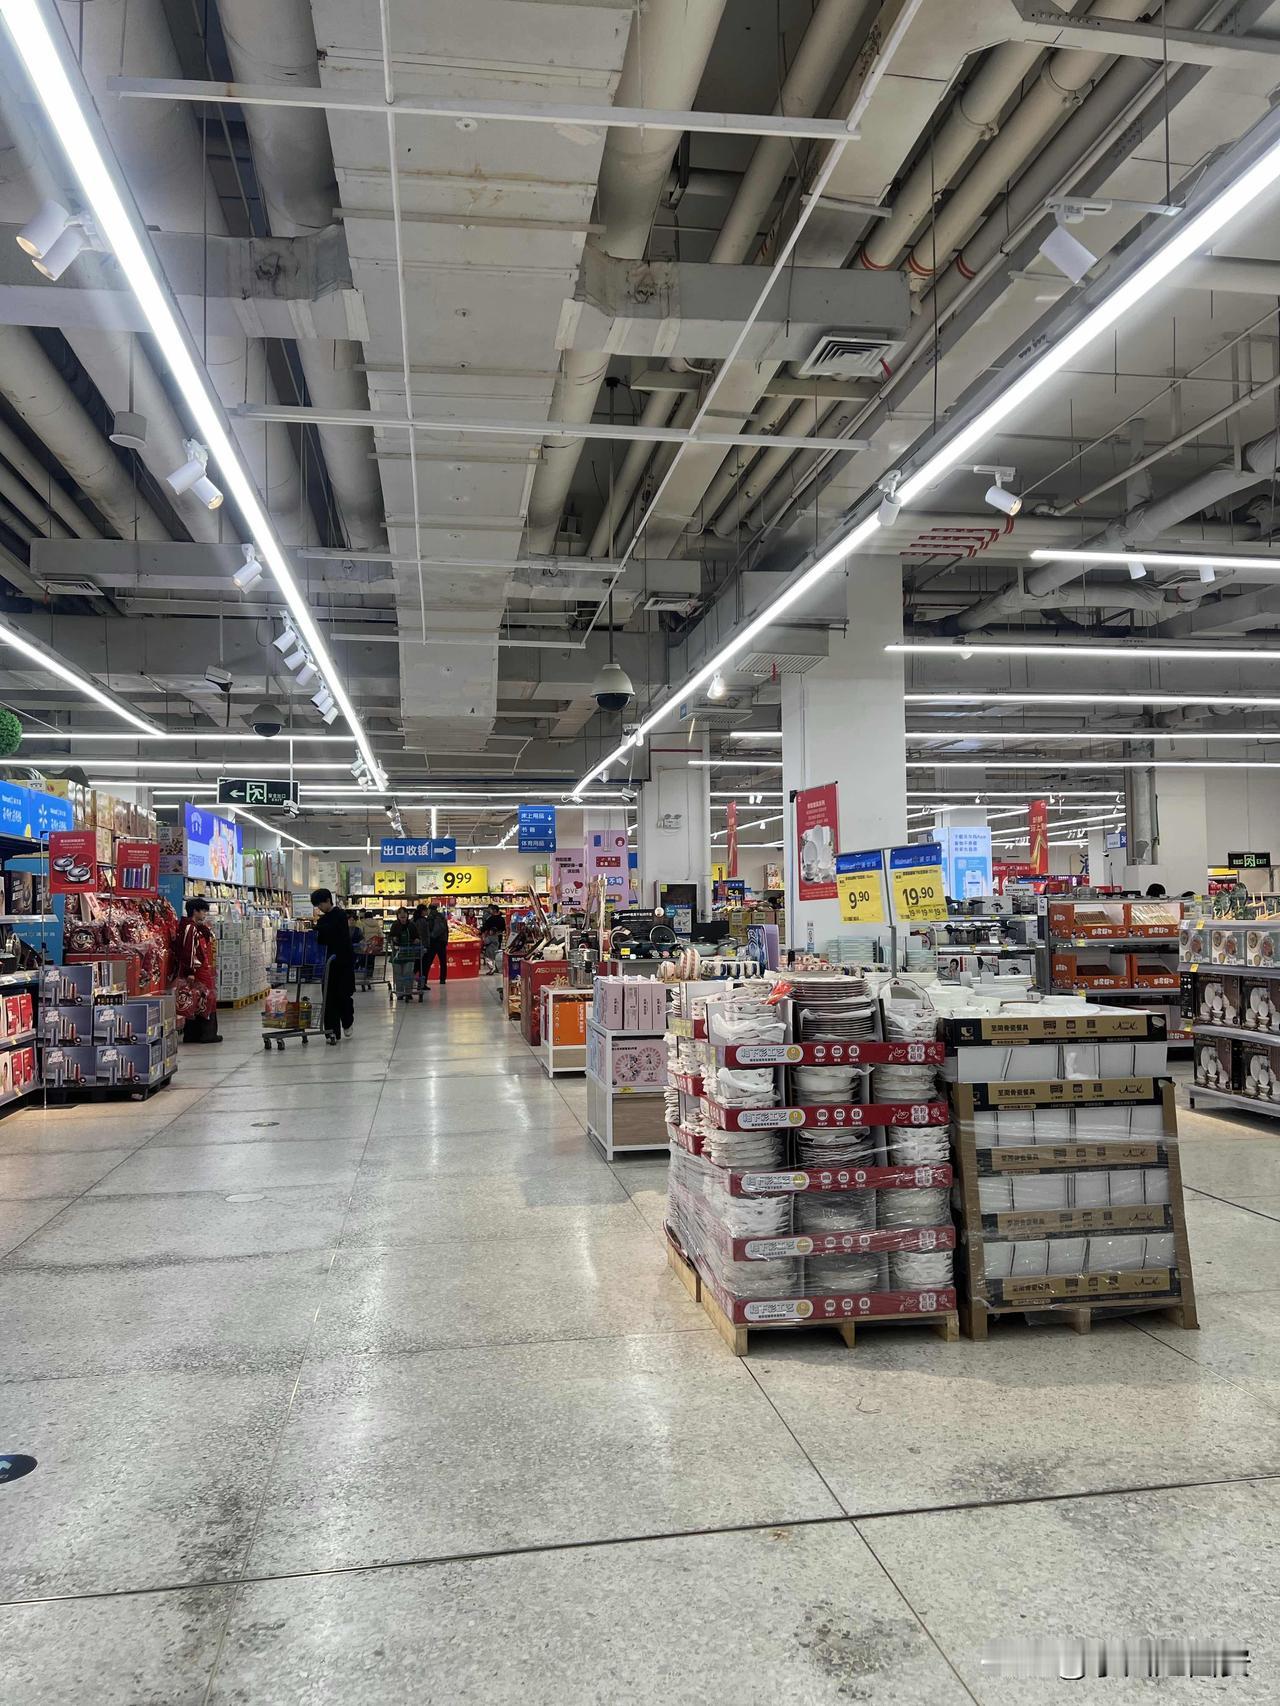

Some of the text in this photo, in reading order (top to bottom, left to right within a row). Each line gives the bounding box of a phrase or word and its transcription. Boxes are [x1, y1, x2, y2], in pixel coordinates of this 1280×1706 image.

[383, 845, 429, 856] 出口收银
[444, 872, 472, 889] 9.99
[849, 891, 870, 909] 9.90
[903, 887, 934, 906] 19.90
